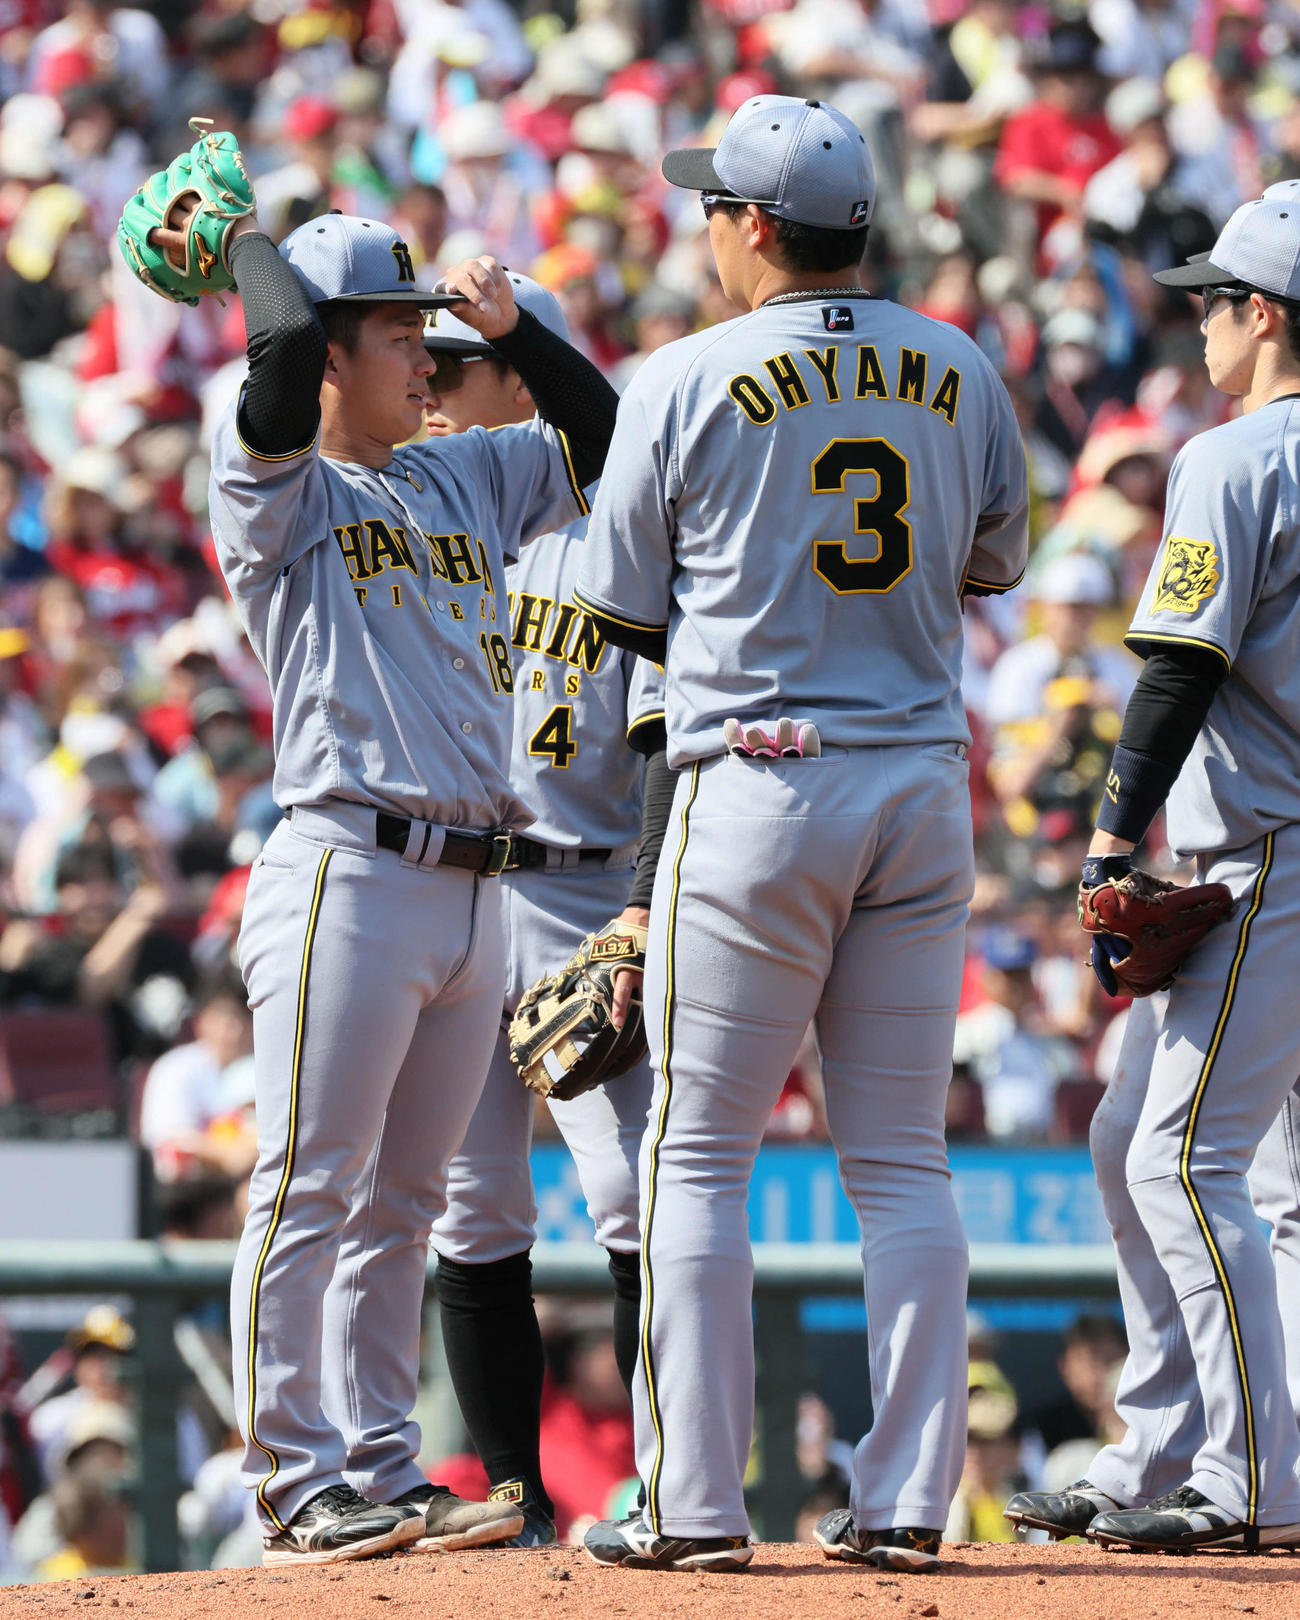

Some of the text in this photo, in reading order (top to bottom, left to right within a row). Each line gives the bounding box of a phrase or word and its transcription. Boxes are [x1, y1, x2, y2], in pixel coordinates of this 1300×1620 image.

[728, 345, 962, 427] OHYAMA
[811, 437, 914, 596] 3
[479, 631, 514, 696] 18
[528, 704, 578, 769] 4
[594, 939, 633, 957] ZETT
